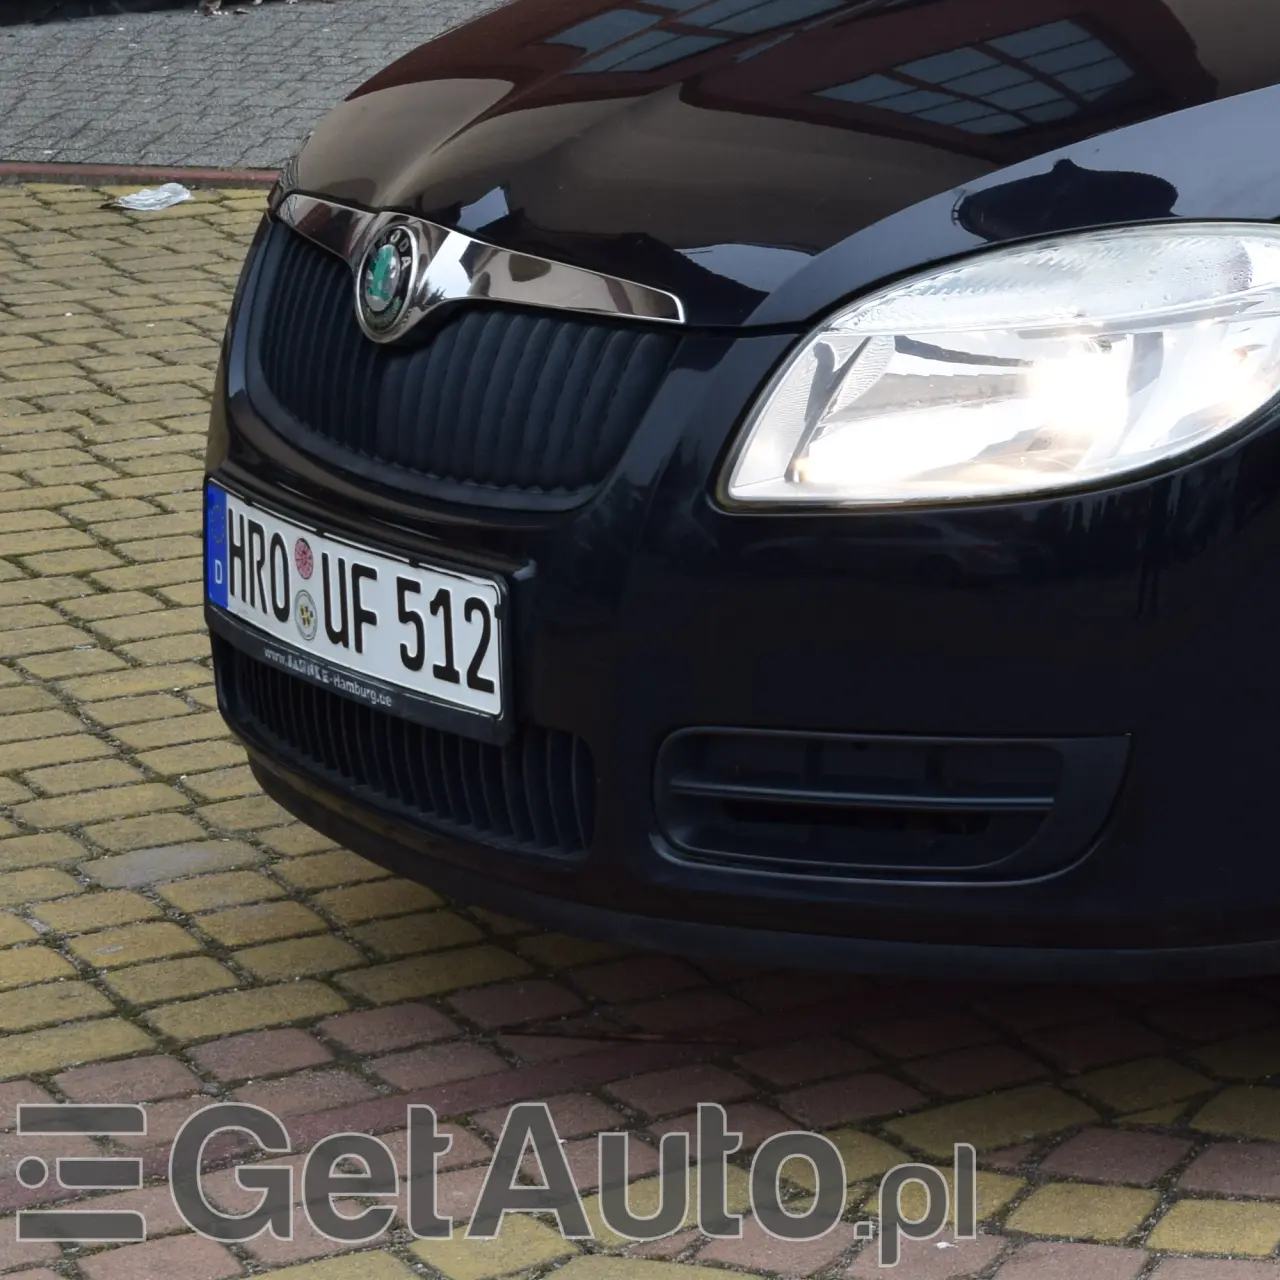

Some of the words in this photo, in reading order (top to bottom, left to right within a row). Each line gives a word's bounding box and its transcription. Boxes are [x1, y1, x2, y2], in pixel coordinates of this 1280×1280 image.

[214, 559, 223, 586] D
[228, 508, 290, 623] HRO
[322, 552, 378, 654] UF
[396, 575, 495, 694] 512
